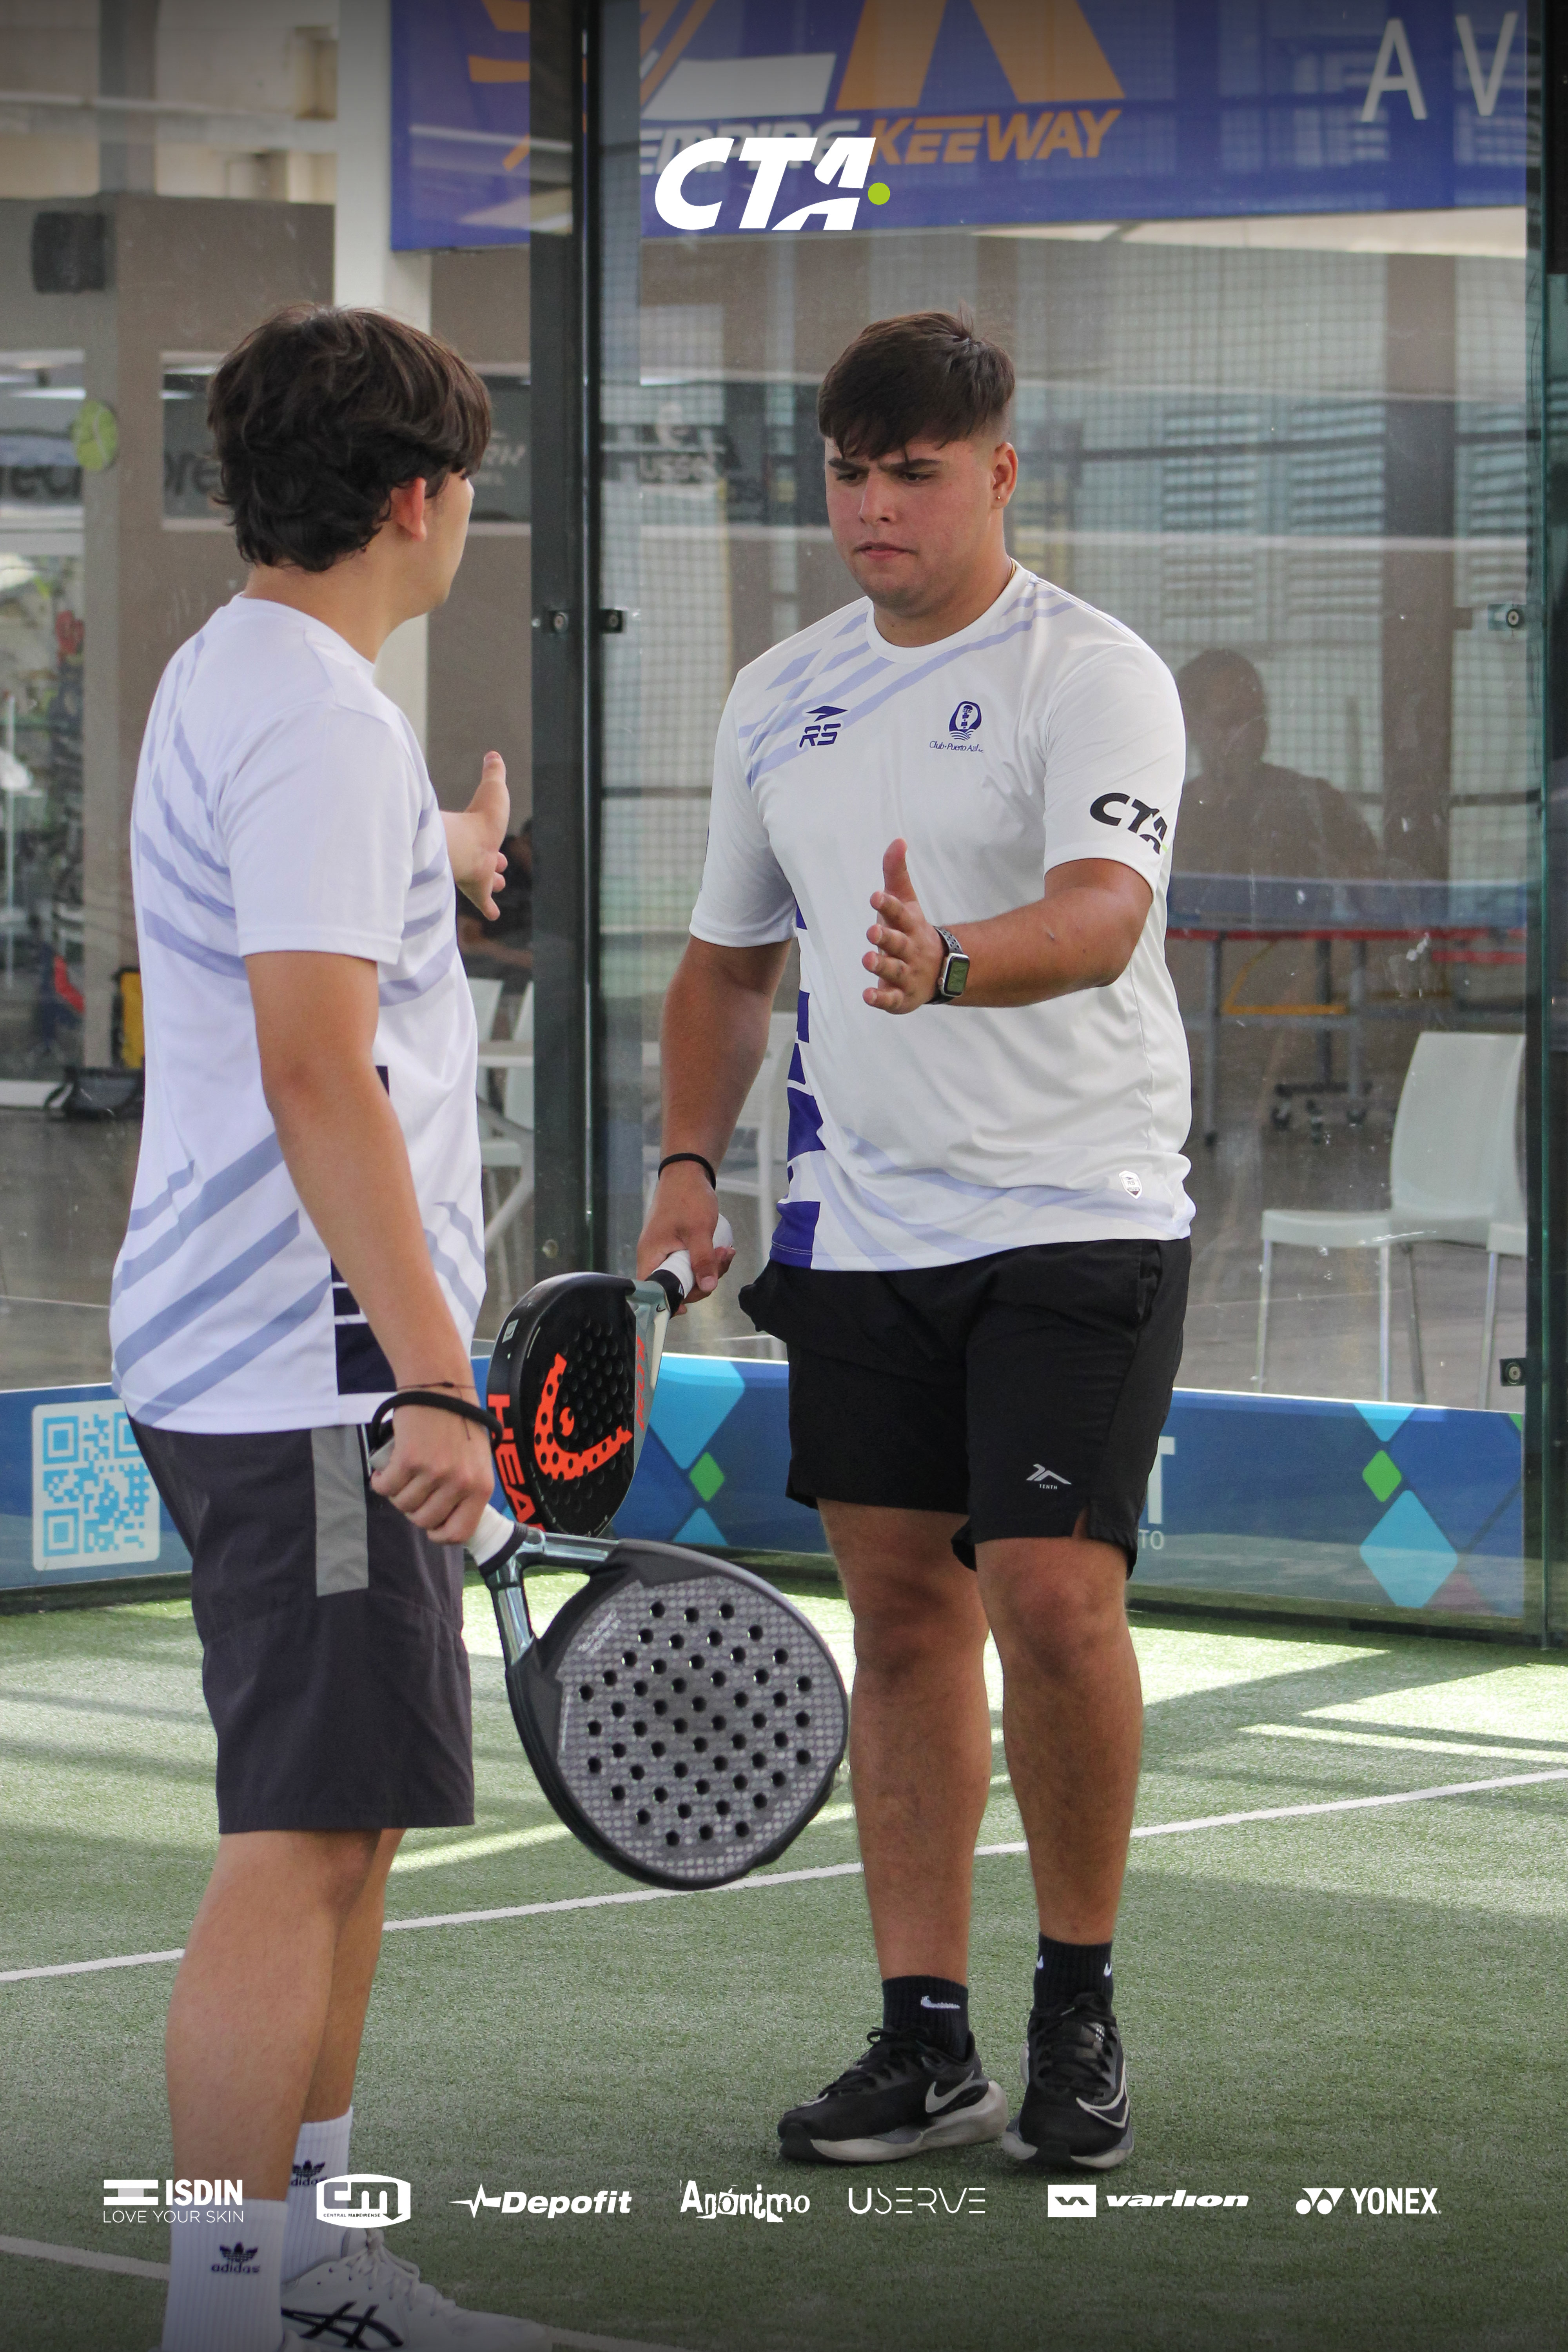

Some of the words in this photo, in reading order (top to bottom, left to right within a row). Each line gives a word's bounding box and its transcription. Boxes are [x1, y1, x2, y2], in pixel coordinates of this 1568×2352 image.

[869, 109, 1122, 166] KEEWAY
[799, 723, 841, 748] RS
[1090, 793, 1167, 855] CTA
[488, 1394, 546, 1532] HEA
[211, 2263, 260, 2273] adidas
